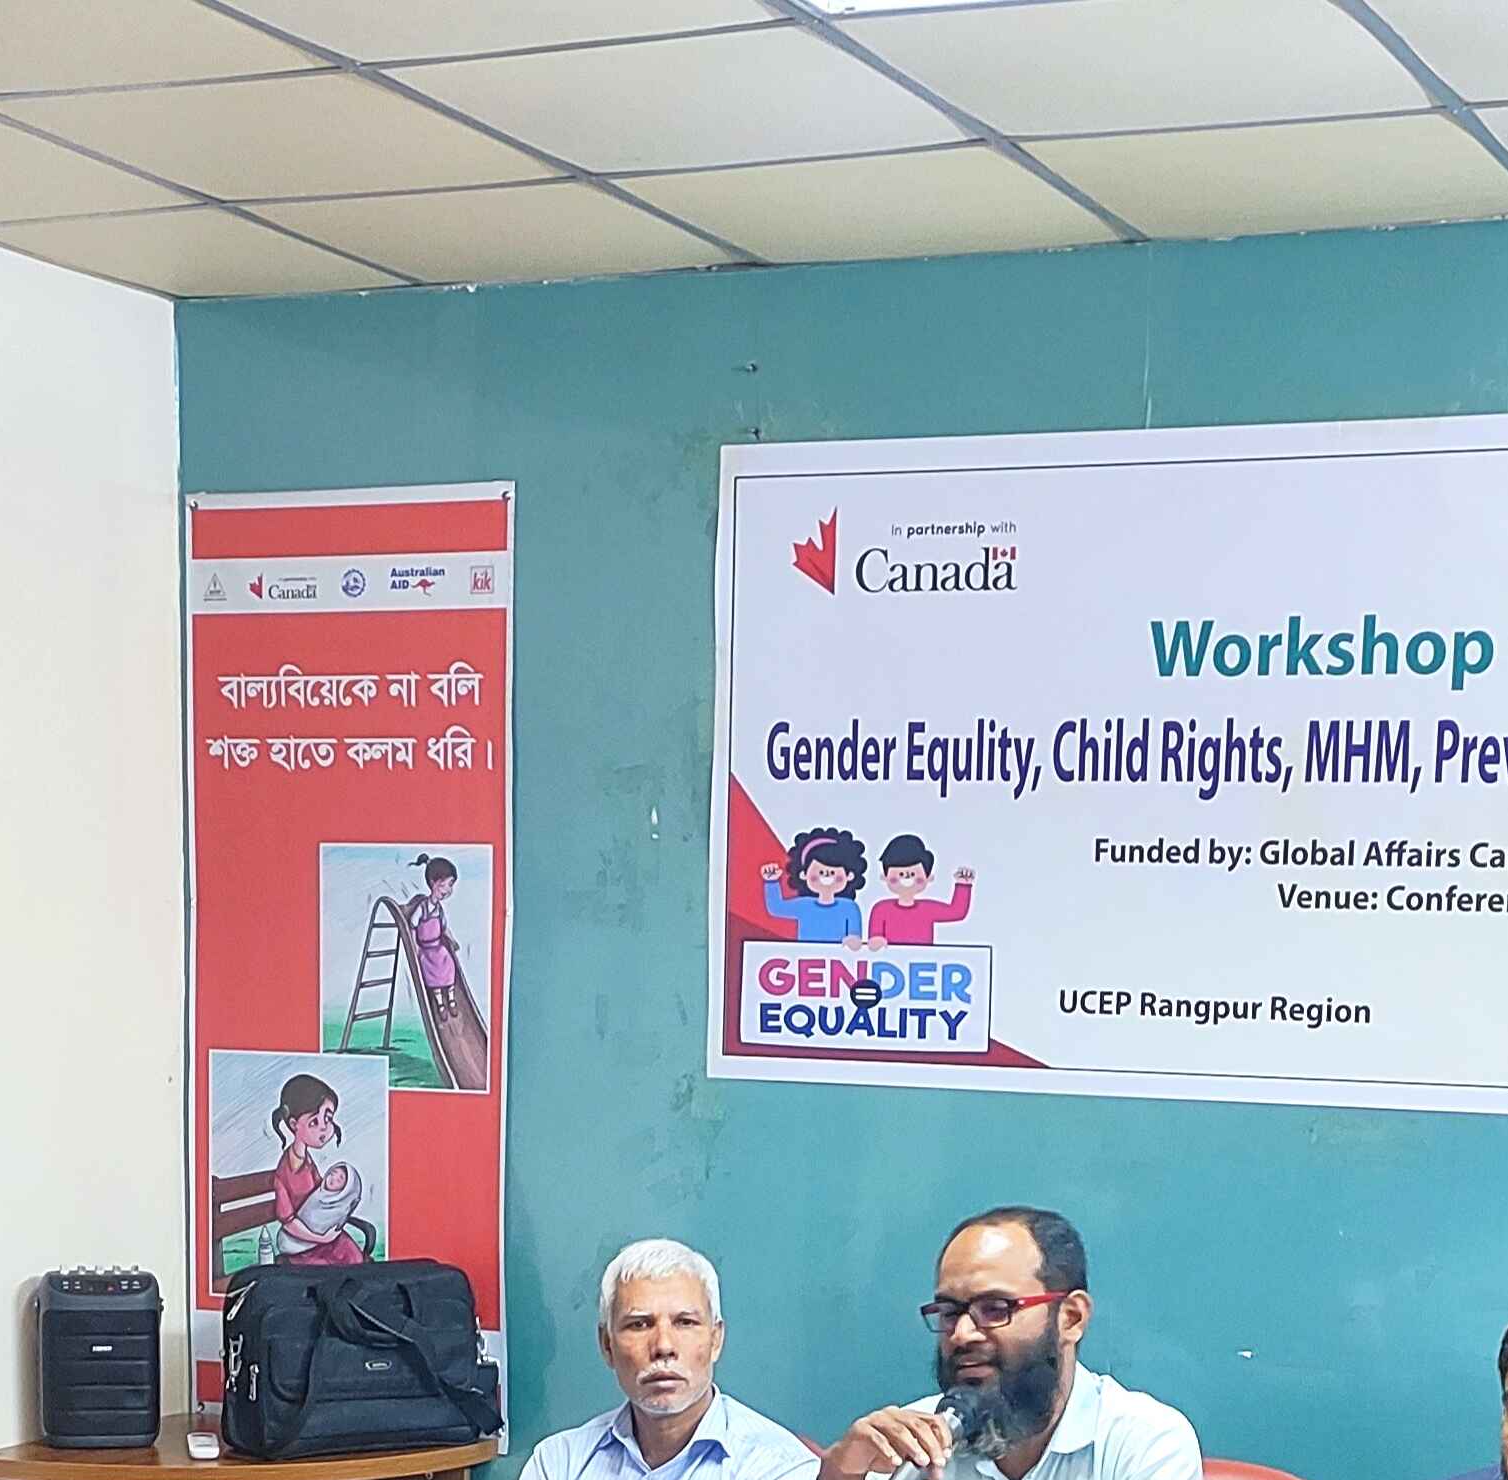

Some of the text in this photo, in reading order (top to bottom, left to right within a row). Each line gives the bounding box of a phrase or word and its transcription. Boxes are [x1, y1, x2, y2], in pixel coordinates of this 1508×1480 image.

[907, 521, 986, 539] partnership
[991, 521, 1017, 533] with
[390, 567, 445, 578] Australian
[390, 579, 410, 590] AID
[854, 546, 1017, 593] Canada
[268, 583, 317, 600] Canada
[1149, 614, 1493, 691] Workshop
[387, 672, 420, 707] না
[427, 661, 483, 707] বলি
[206, 737, 260, 770] শক্ত
[267, 736, 337, 772] হাতে
[345, 737, 417, 770] কলম
[426, 725, 476, 770] ধরি
[767, 718, 896, 784] Gender
[907, 718, 1041, 799] Equlity,
[1053, 718, 1149, 784] Child
[1161, 718, 1292, 800] Rights,
[1306, 719, 1422, 794] MHM,
[1094, 838, 1202, 865] Funded
[1208, 839, 1253, 873] by:
[1259, 840, 1354, 867] Global
[1363, 841, 1461, 869] Affairs
[1277, 883, 1378, 911] Venue:
[758, 958, 972, 1004] GENDER
[759, 1003, 969, 1041] EQUALITY
[1059, 990, 1372, 1026] UCEP Rangpur Region
